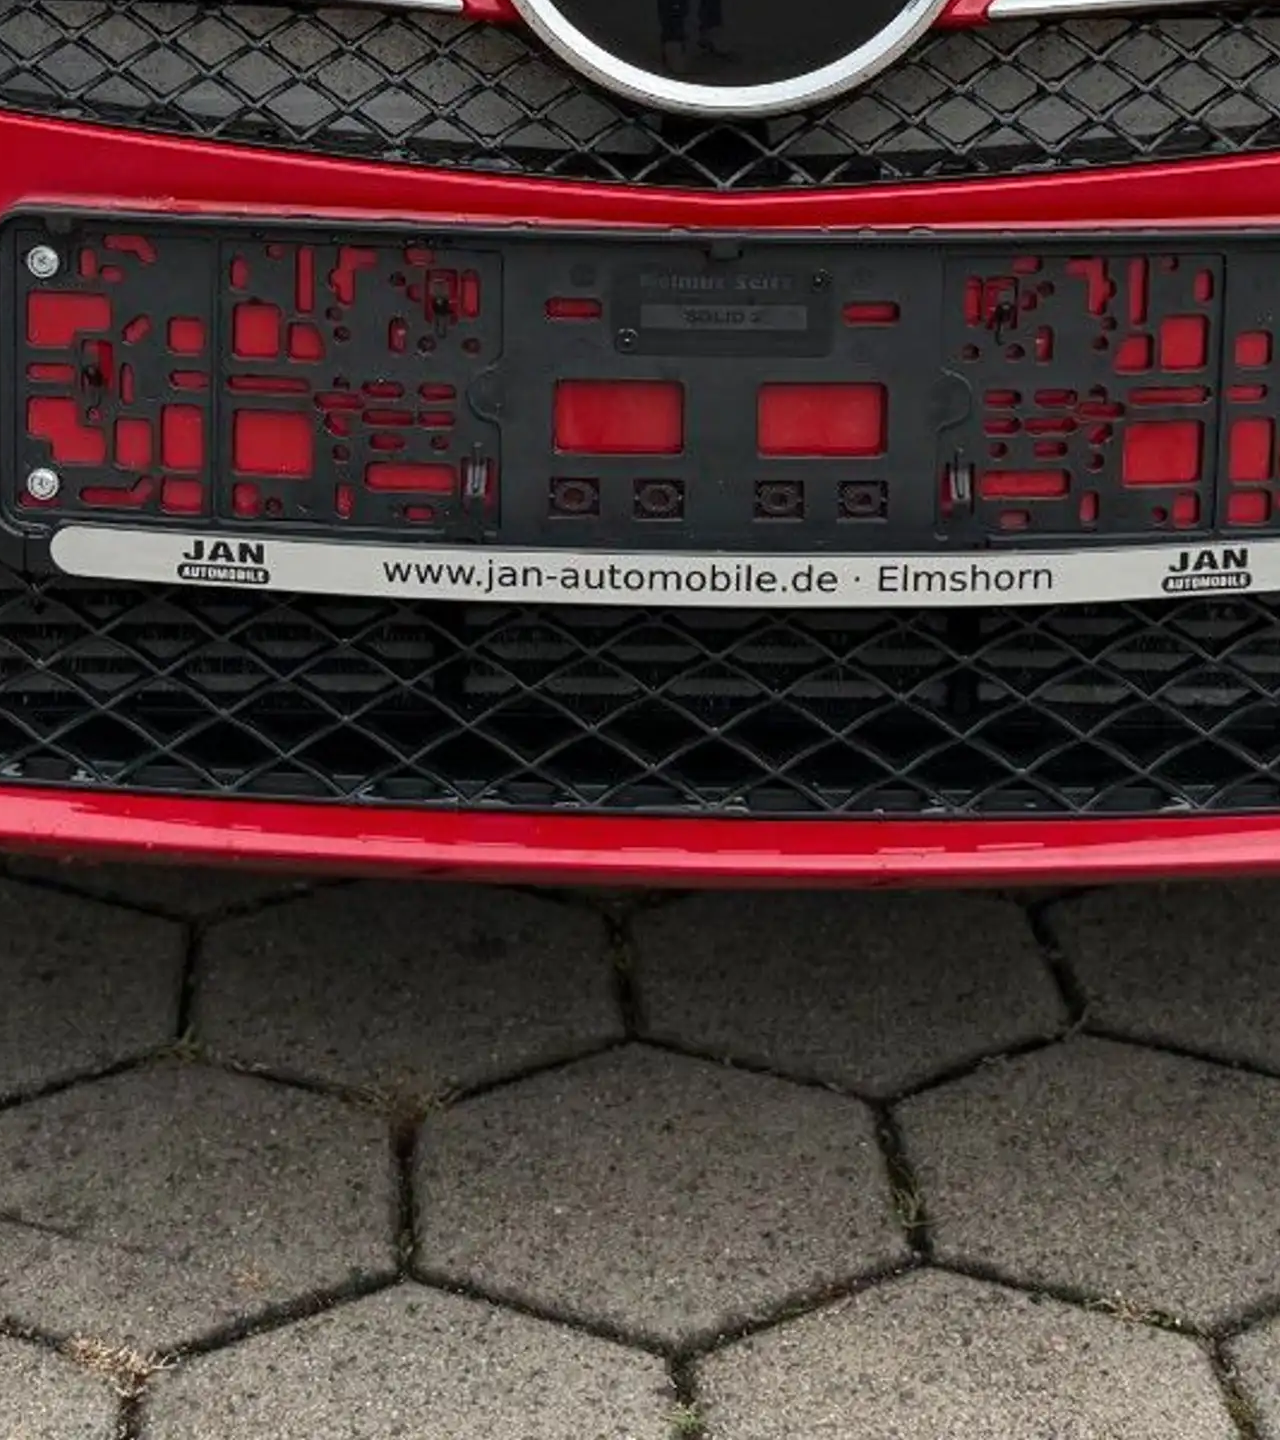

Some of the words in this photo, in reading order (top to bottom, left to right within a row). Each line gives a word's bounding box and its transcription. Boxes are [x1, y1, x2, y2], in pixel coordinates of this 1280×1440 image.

[182, 539, 265, 565] JAN
[1167, 547, 1249, 572] JAN
[181, 564, 266, 583] AUTOMOBILE
[382, 558, 839, 594] www.jan-automobile.de
[877, 563, 1054, 592] Elmshorn
[1165, 571, 1248, 590] AUTOMOBILE
